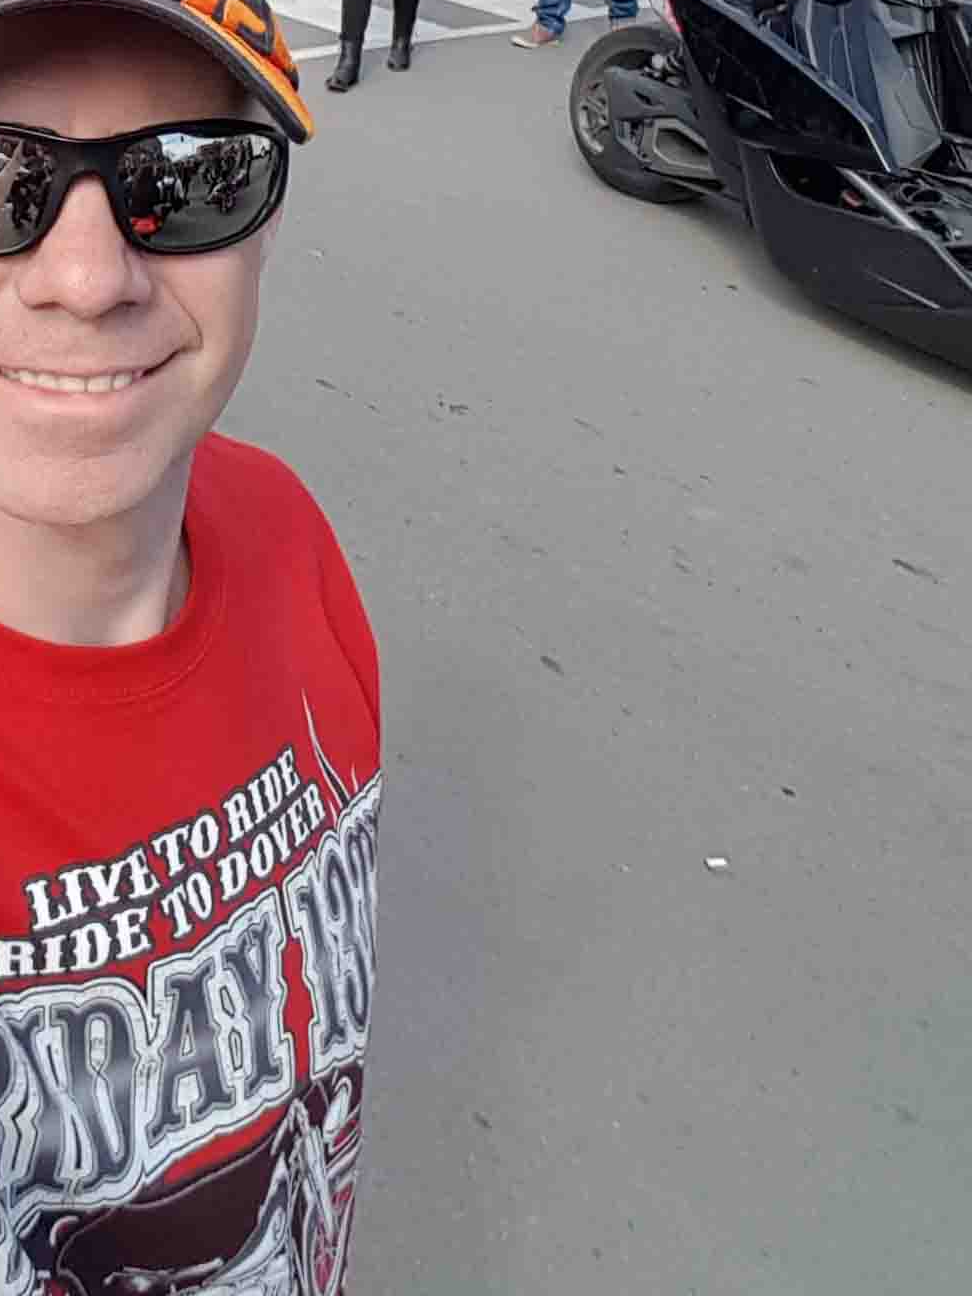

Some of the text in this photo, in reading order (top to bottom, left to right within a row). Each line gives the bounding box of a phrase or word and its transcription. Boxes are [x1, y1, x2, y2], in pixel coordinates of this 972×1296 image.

[25, 746, 301, 931] LIVE TO RIDE
[160, 871, 213, 939] TO
[216, 783, 326, 901] DOVER
